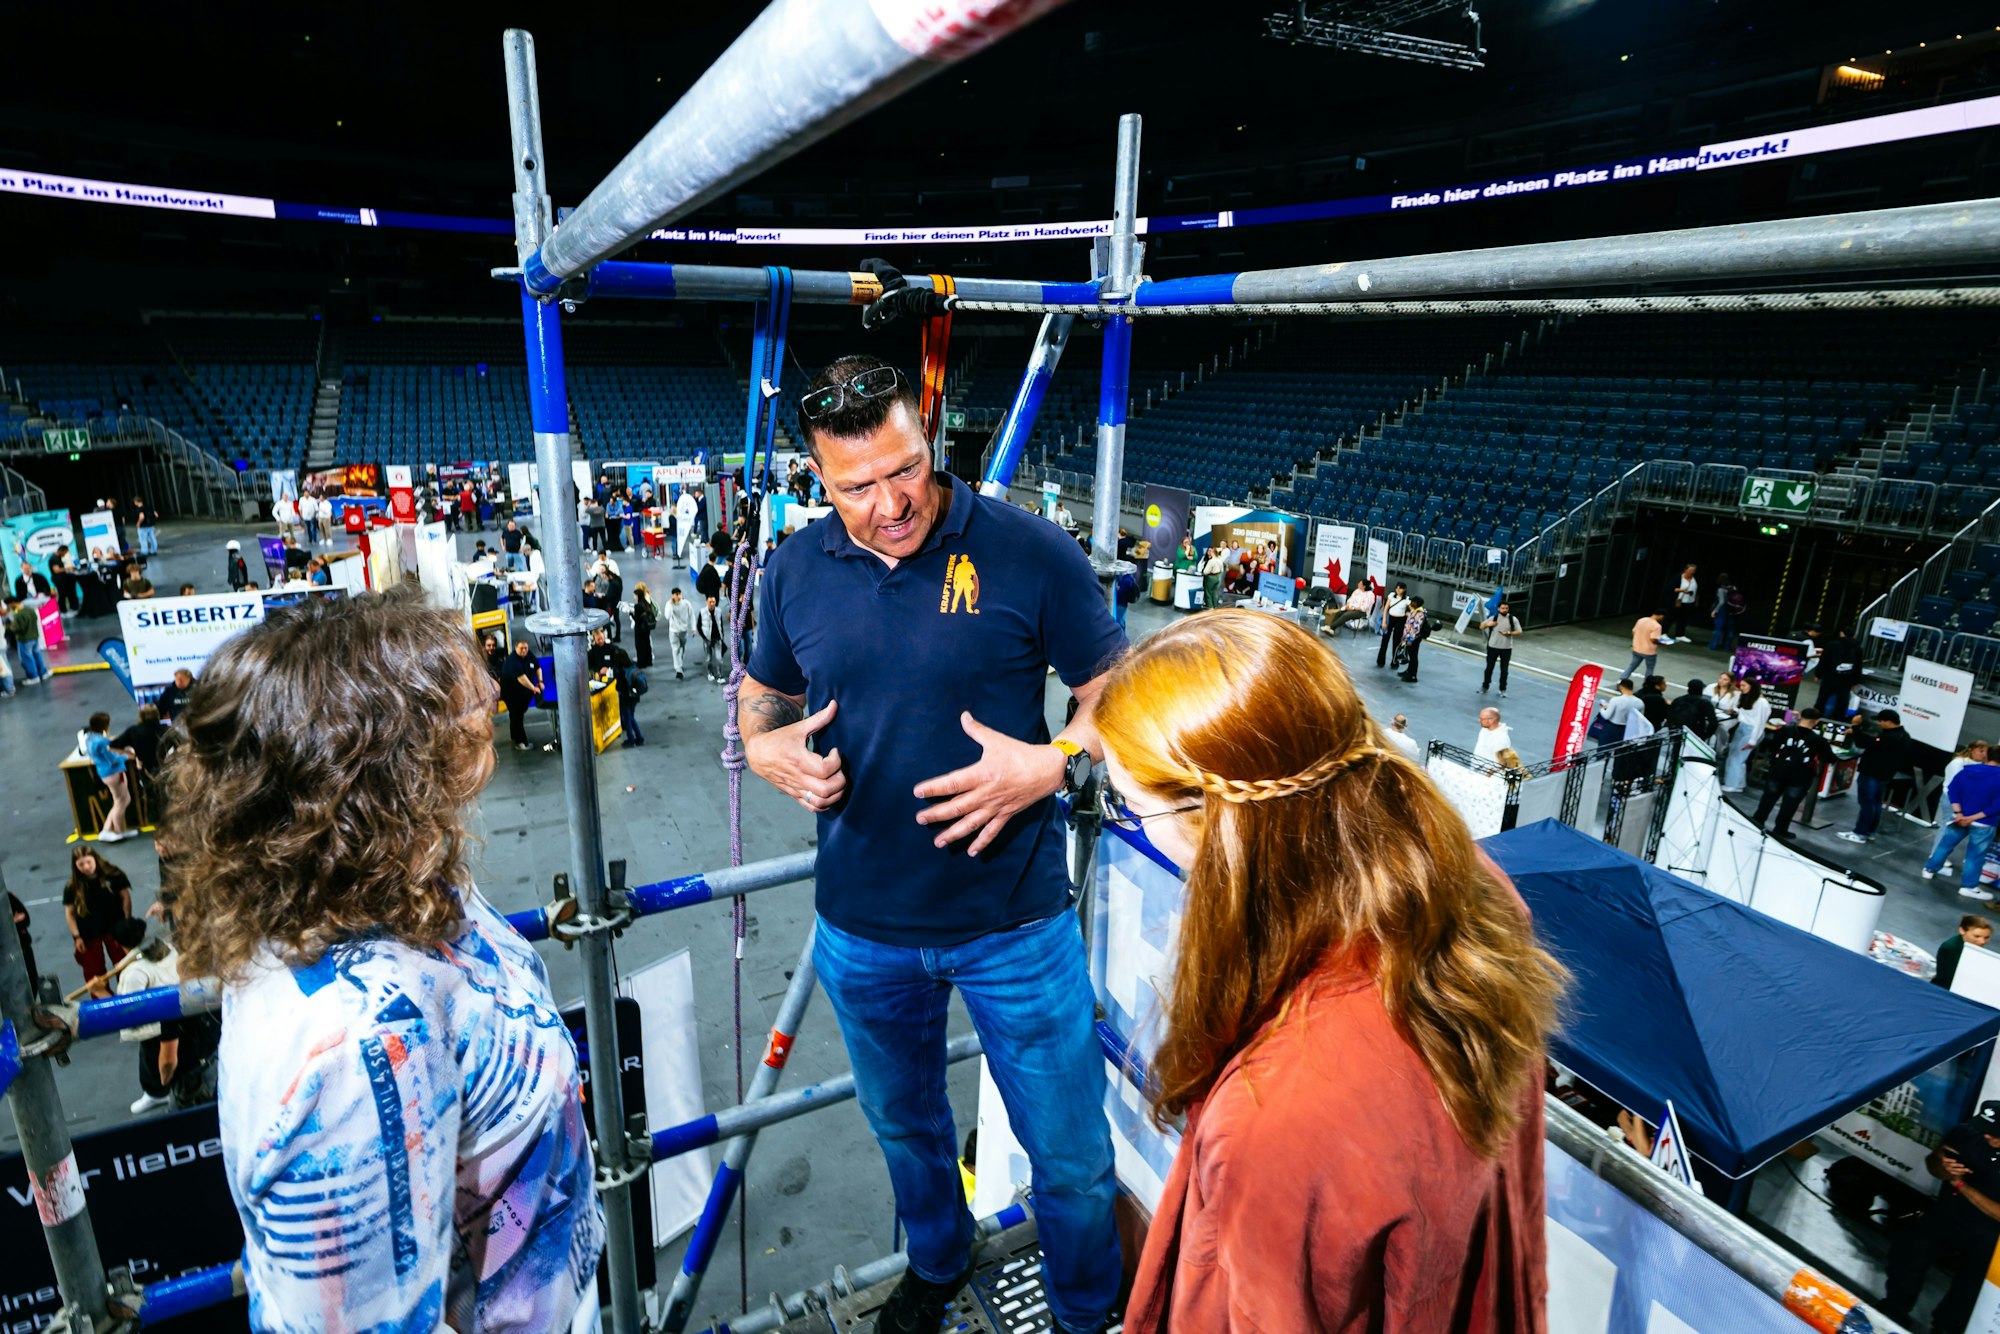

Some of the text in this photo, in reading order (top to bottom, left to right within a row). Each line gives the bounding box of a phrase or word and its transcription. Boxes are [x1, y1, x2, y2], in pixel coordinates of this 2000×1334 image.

[1391, 138, 1791, 209] Finde hier deinen Platz im Handwerk!
[22, 177, 76, 194] Platz
[83, 186, 110, 198] im
[115, 188, 225, 209] Handwerk!
[651, 228, 781, 242] Platz im Handwerk!
[864, 224, 1110, 242] Finde hier deinen Platz im Handwerk!
[1747, 641, 1776, 653] LANXESS
[1910, 673, 1959, 694] LANXESS arena
[1857, 687, 1899, 707] ANXESS
[1828, 1123, 1913, 1173] ienerberger
